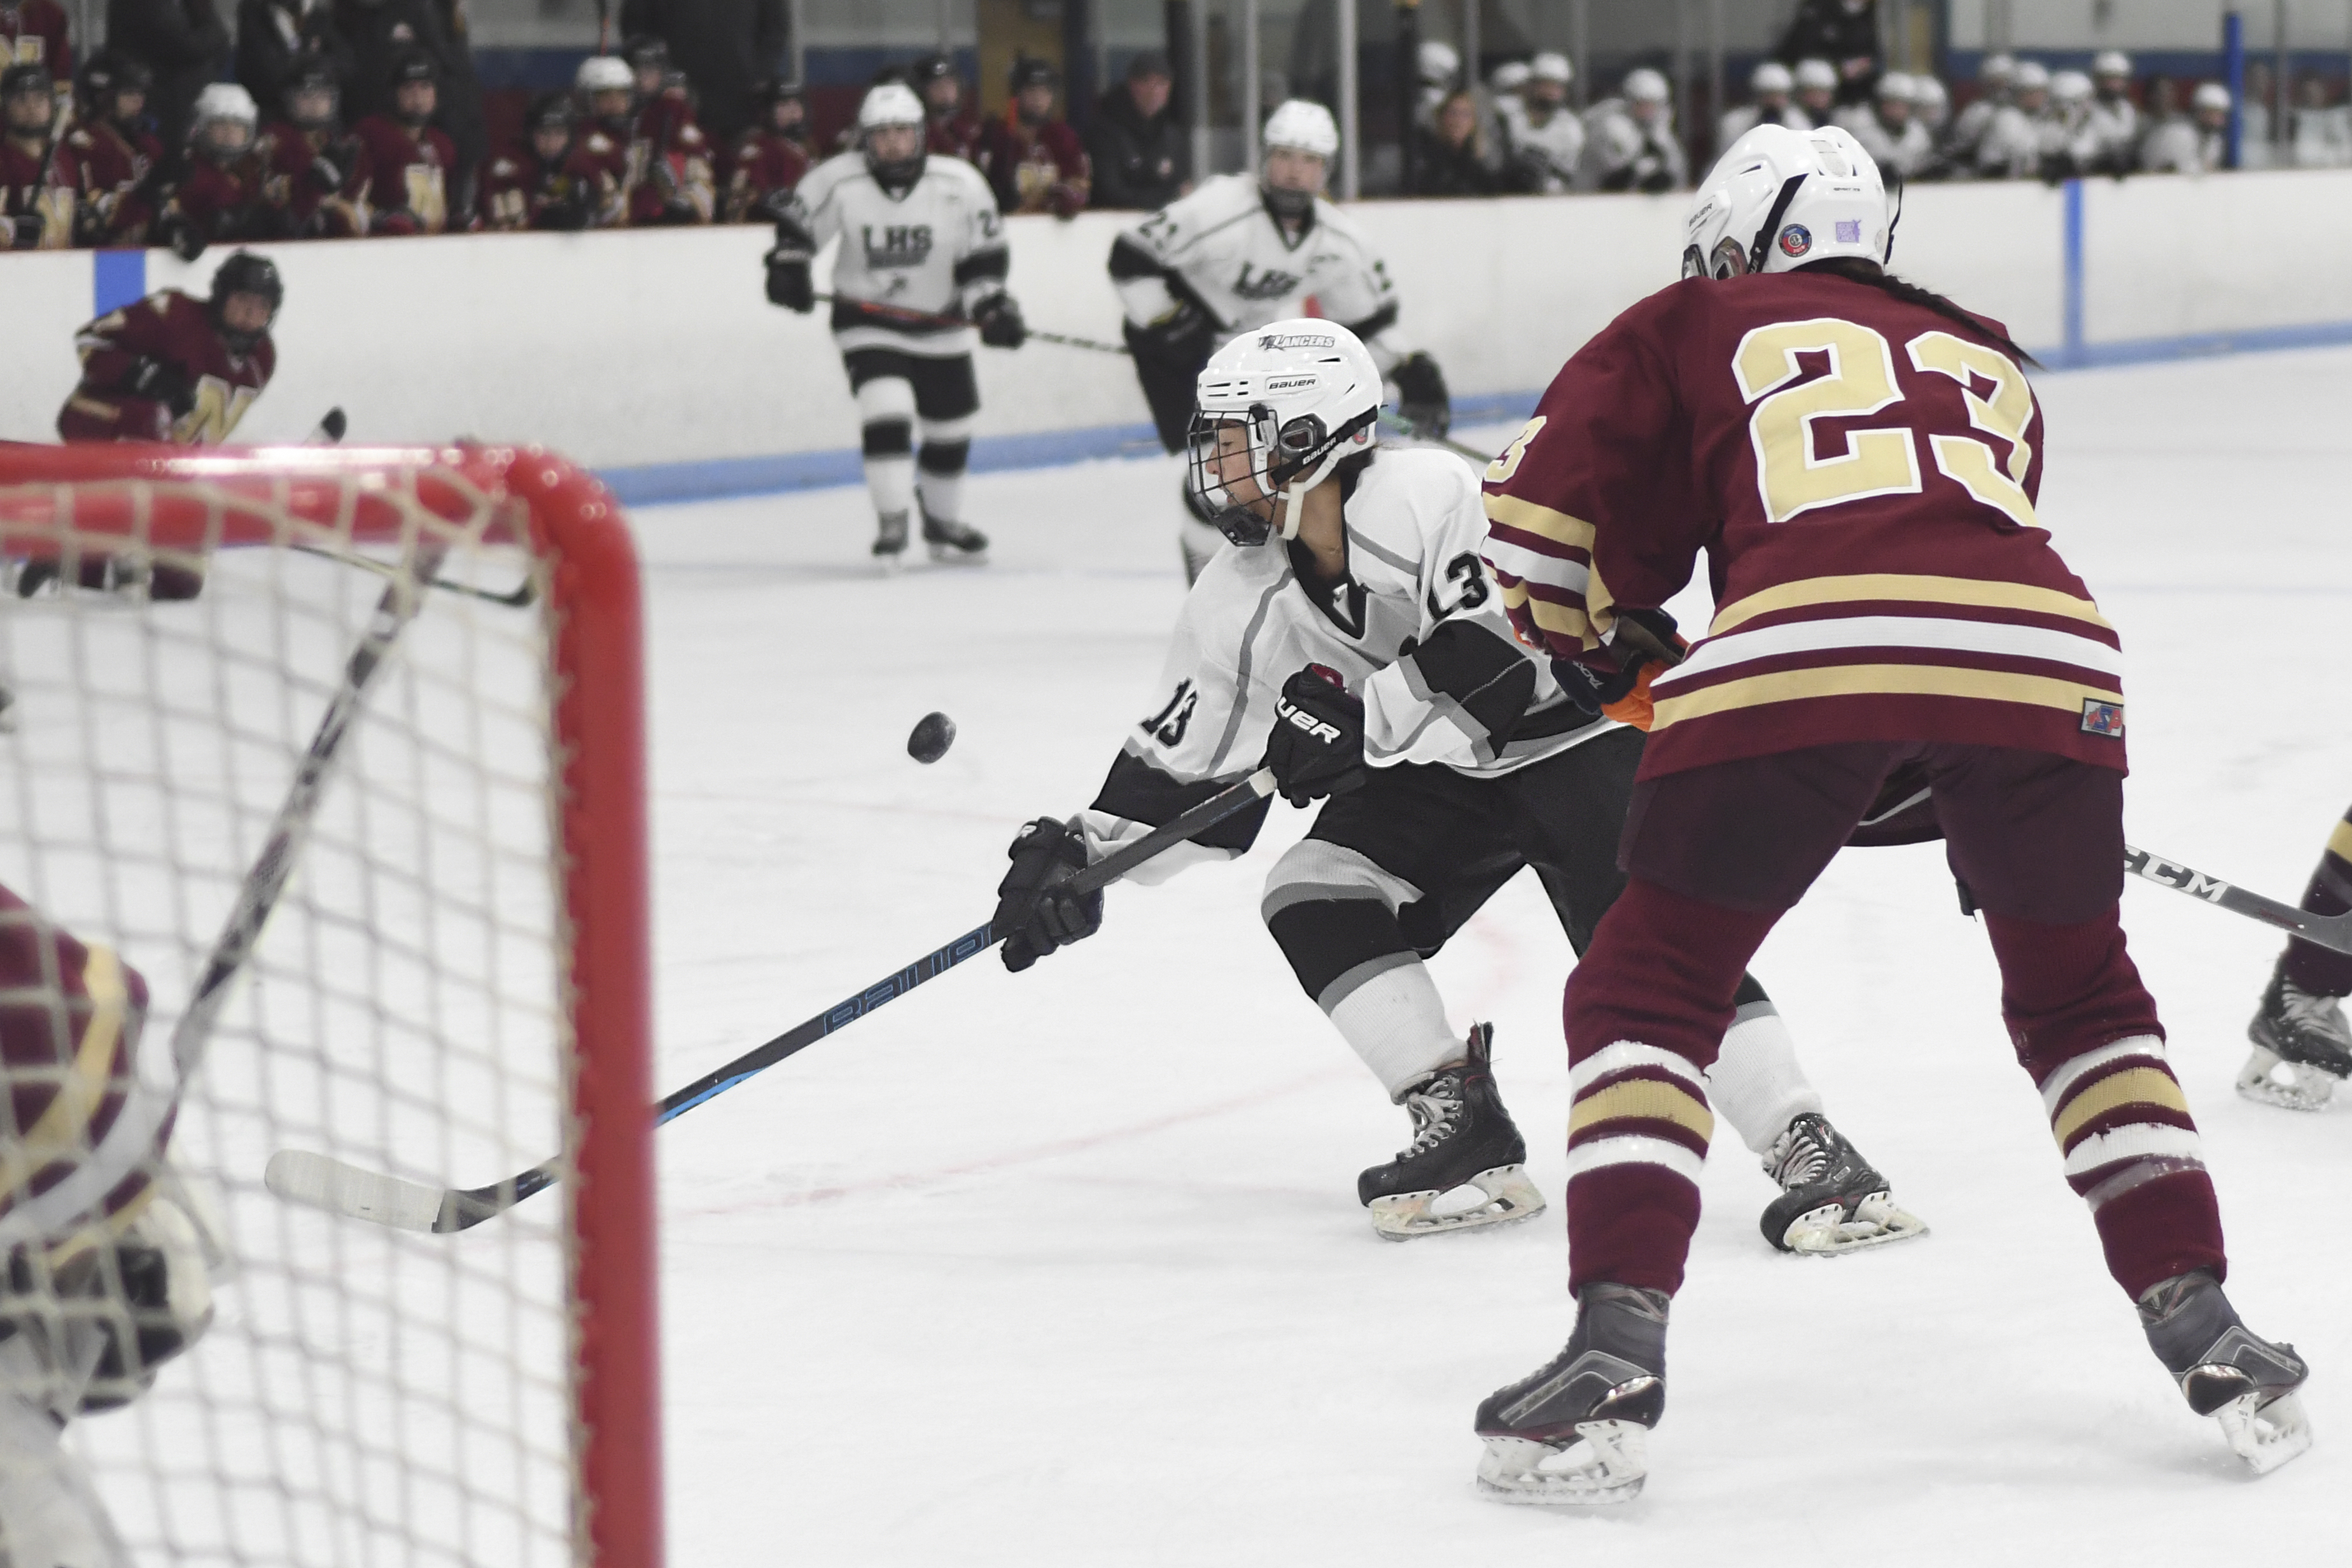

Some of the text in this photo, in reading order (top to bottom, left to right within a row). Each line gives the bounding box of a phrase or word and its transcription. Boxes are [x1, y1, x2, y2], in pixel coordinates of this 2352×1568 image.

[862, 224, 932, 257] LHS
[1271, 334, 1335, 348] LANCERS
[1269, 379, 1316, 389] BAUER
[1732, 318, 2038, 528] 23
[1303, 437, 1336, 465] BAUER
[1137, 677, 1199, 749] 13
[1277, 696, 1341, 744] UER
[823, 924, 993, 1035] BAUE
